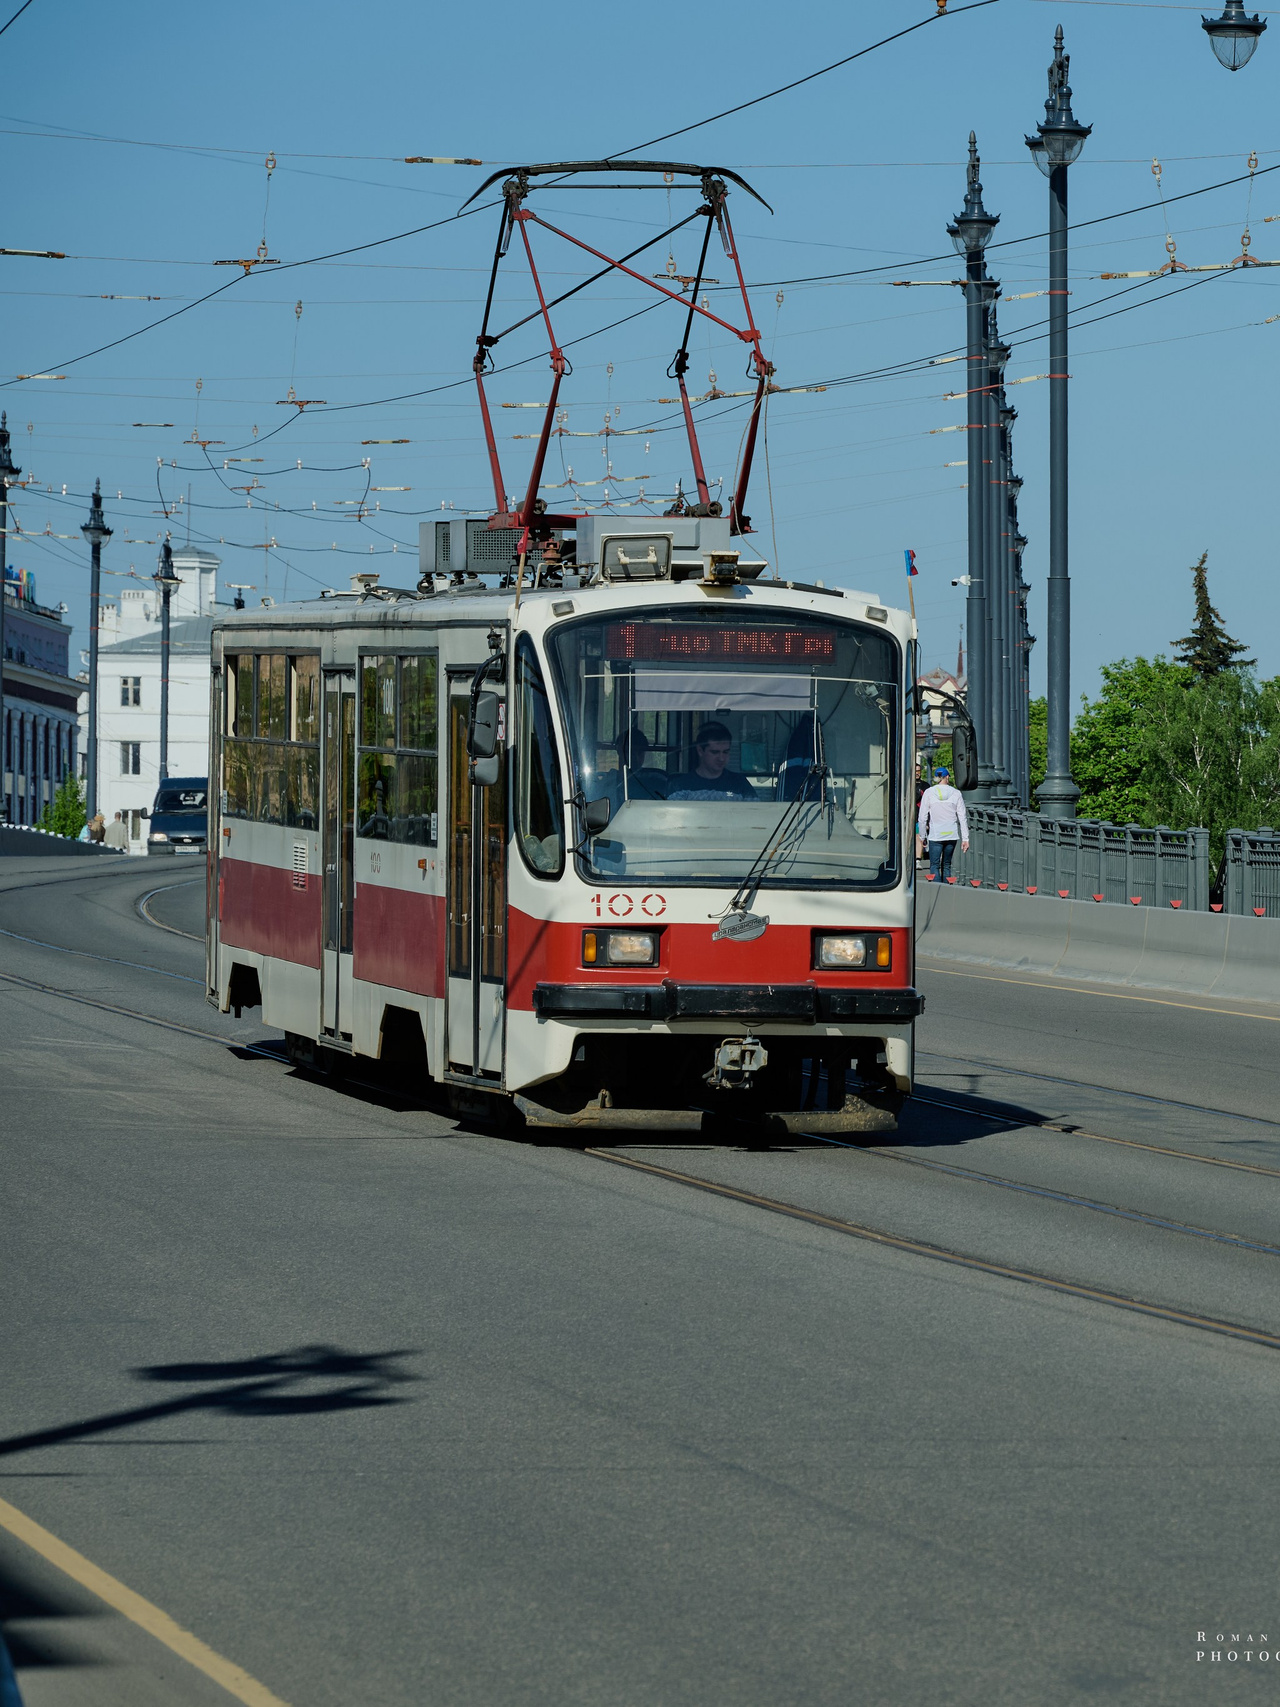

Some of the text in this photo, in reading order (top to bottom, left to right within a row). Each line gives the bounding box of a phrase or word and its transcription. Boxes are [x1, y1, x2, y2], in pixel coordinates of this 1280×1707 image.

[620, 624, 635, 658] 1
[718, 631, 777, 652] ТМК
[383, 678, 394, 715] 100
[370, 852, 382, 874] 100
[590, 893, 667, 917] 100
